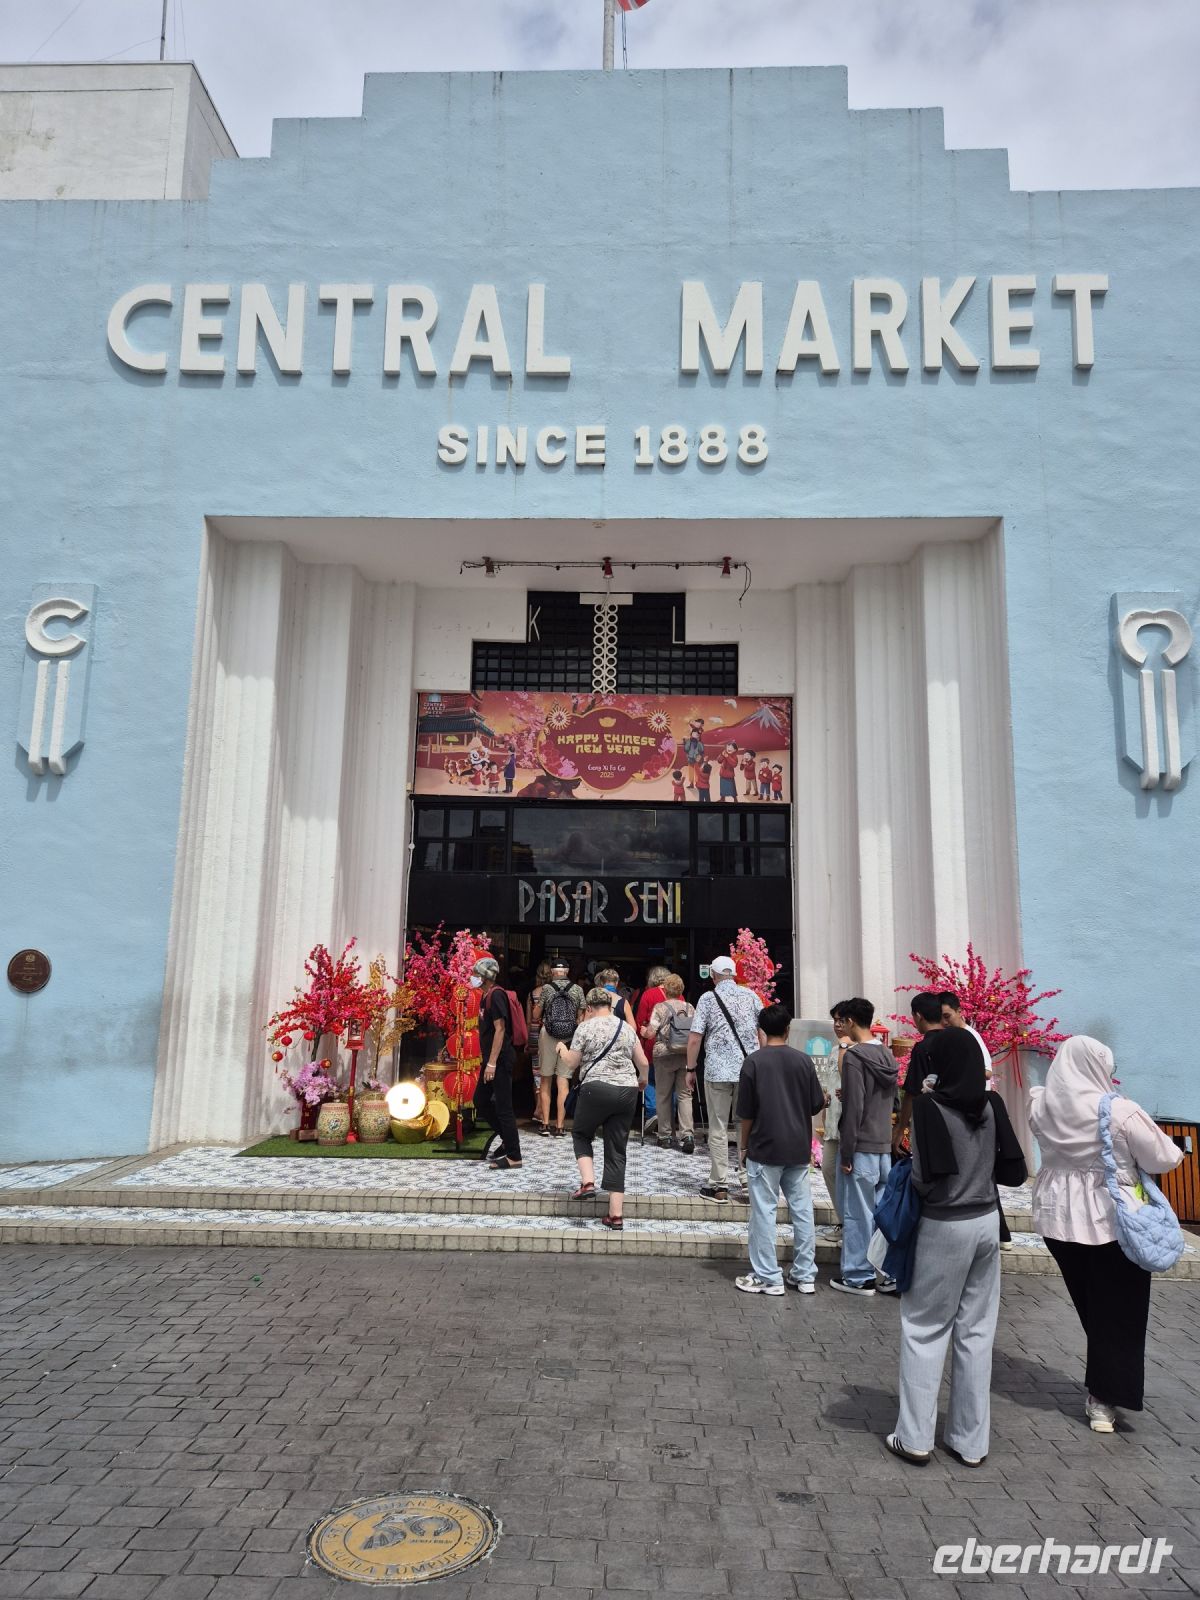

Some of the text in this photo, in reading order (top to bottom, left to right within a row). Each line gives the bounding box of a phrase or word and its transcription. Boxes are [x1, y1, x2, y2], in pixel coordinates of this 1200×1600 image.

[107, 274, 1109, 376] CENTRAL MARKET
[437, 424, 769, 467] SINCE 1888
[557, 734, 656, 747] HAPPY CHINESE
[576, 744, 640, 755] NEW YEAR
[518, 879, 682, 924] PASAR SENI
[329, 1549, 463, 1576] KUALA LUMPUR
